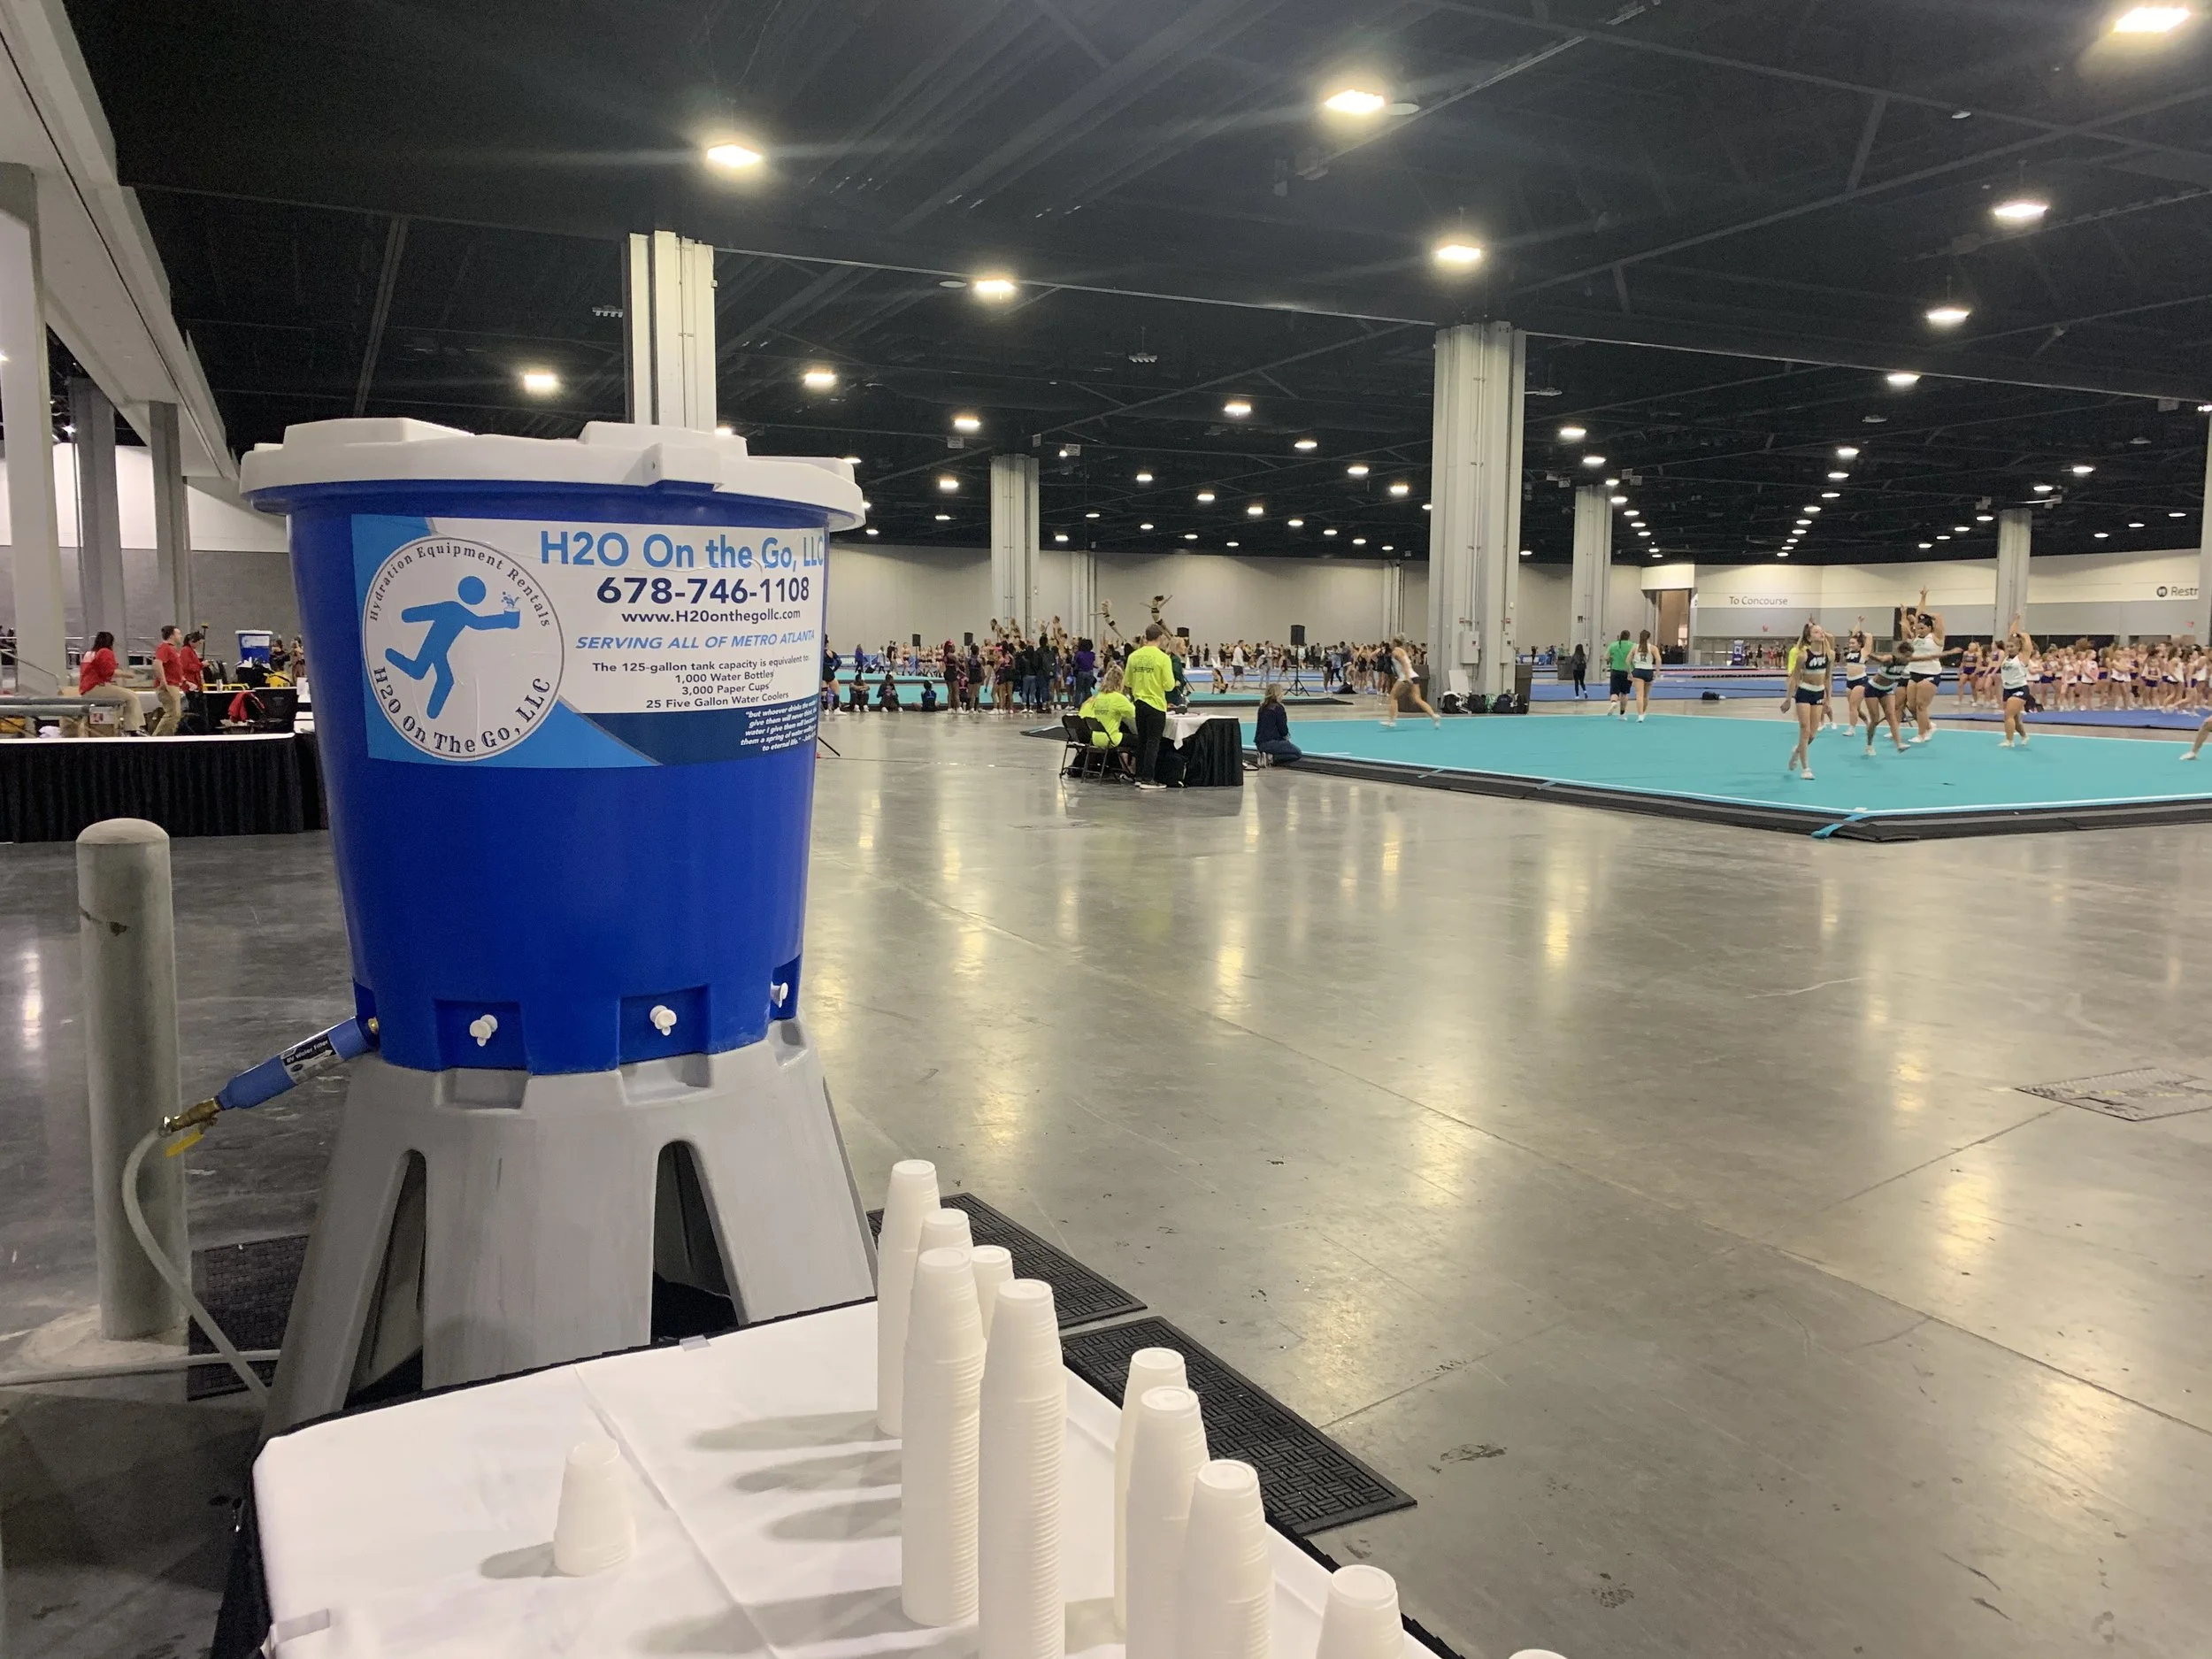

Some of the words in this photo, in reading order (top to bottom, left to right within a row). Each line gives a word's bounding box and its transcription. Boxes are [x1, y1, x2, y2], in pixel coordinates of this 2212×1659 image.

[541, 531, 629, 565] H2O
[643, 534, 694, 568] On
[705, 534, 752, 569] the
[762, 537, 797, 572] Go,
[803, 535, 824, 566] LLC
[370, 552, 413, 621] Hydration
[417, 541, 503, 571] Equipment
[507, 568, 550, 627] Rentals
[597, 576, 810, 604] 678-746-1108
[1729, 596, 1740, 605] To
[1741, 596, 1788, 605] Concourse
[575, 636, 663, 649] SERVING
[667, 636, 699, 649] ALL
[704, 635, 728, 649] OF
[731, 633, 777, 648] METRO
[780, 629, 815, 645] ATLANTA
[592, 662, 617, 672] The
[622, 662, 687, 674] 125-gallon
[691, 660, 715, 671] tank
[718, 659, 757, 672] capacity
[760, 657, 766, 667] is
[768, 655, 802, 669] equivalent
[675, 673, 707, 685] 1,000
[710, 672, 741, 682] Water
[744, 669, 774, 680] Bottles
[681, 685, 713, 696] 3,000
[717, 684, 746, 696] Paper
[748, 683, 770, 694] Cups
[646, 700, 662, 709] 25
[666, 698, 690, 709] Five
[695, 696, 728, 707] Gallon
[731, 694, 759, 704] Water
[762, 691, 789, 702] Coolers
[373, 665, 402, 714] H2O
[403, 715, 426, 743] On
[434, 732, 475, 753] The
[481, 726, 521, 748] Go,
[515, 678, 550, 723] LLC
[763, 708, 787, 717] whoever
[749, 719, 764, 728] give
[770, 726, 783, 734] give
[765, 734, 784, 743] spring
[771, 740, 790, 750] eternal
